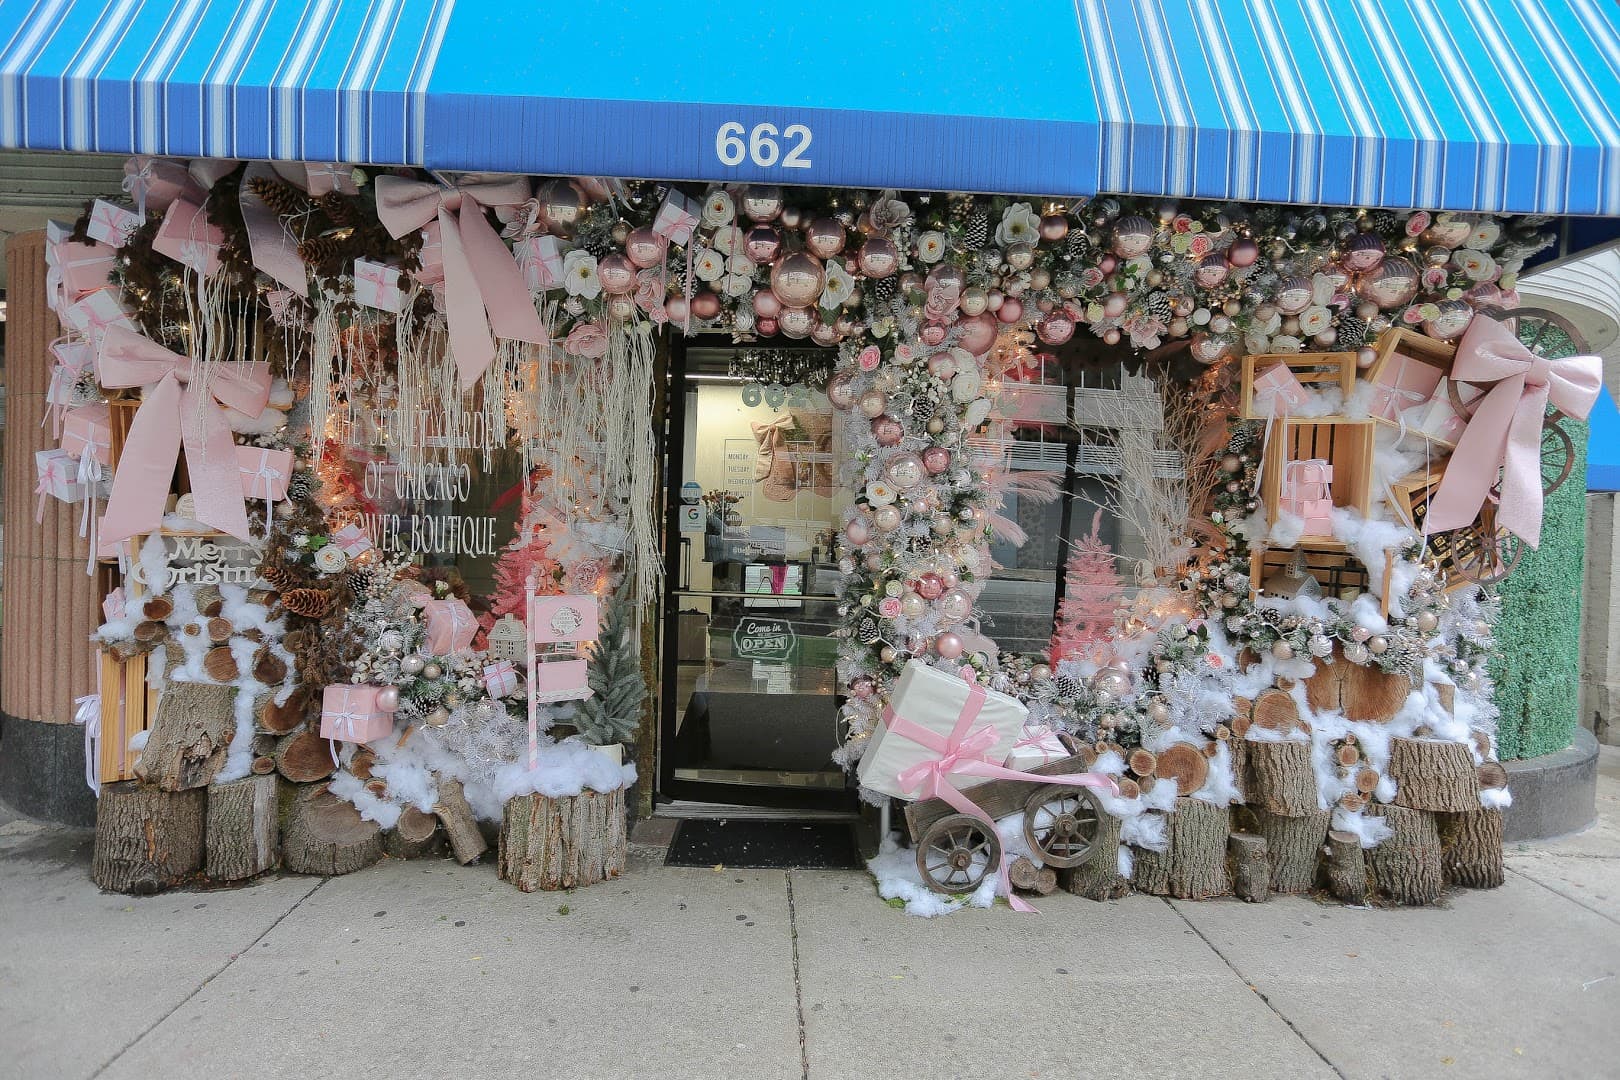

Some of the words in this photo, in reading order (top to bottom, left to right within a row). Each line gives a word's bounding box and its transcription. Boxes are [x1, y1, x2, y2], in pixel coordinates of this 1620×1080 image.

[716, 121, 812, 168] 662
[364, 460, 385, 499] OF
[395, 462, 471, 502] CHICAGO
[167, 536, 265, 567] Merry
[411, 514, 497, 558] BOUTIQUE
[743, 637, 786, 650] OPEN
[747, 623, 771, 634] Come
[772, 623, 782, 632] in
